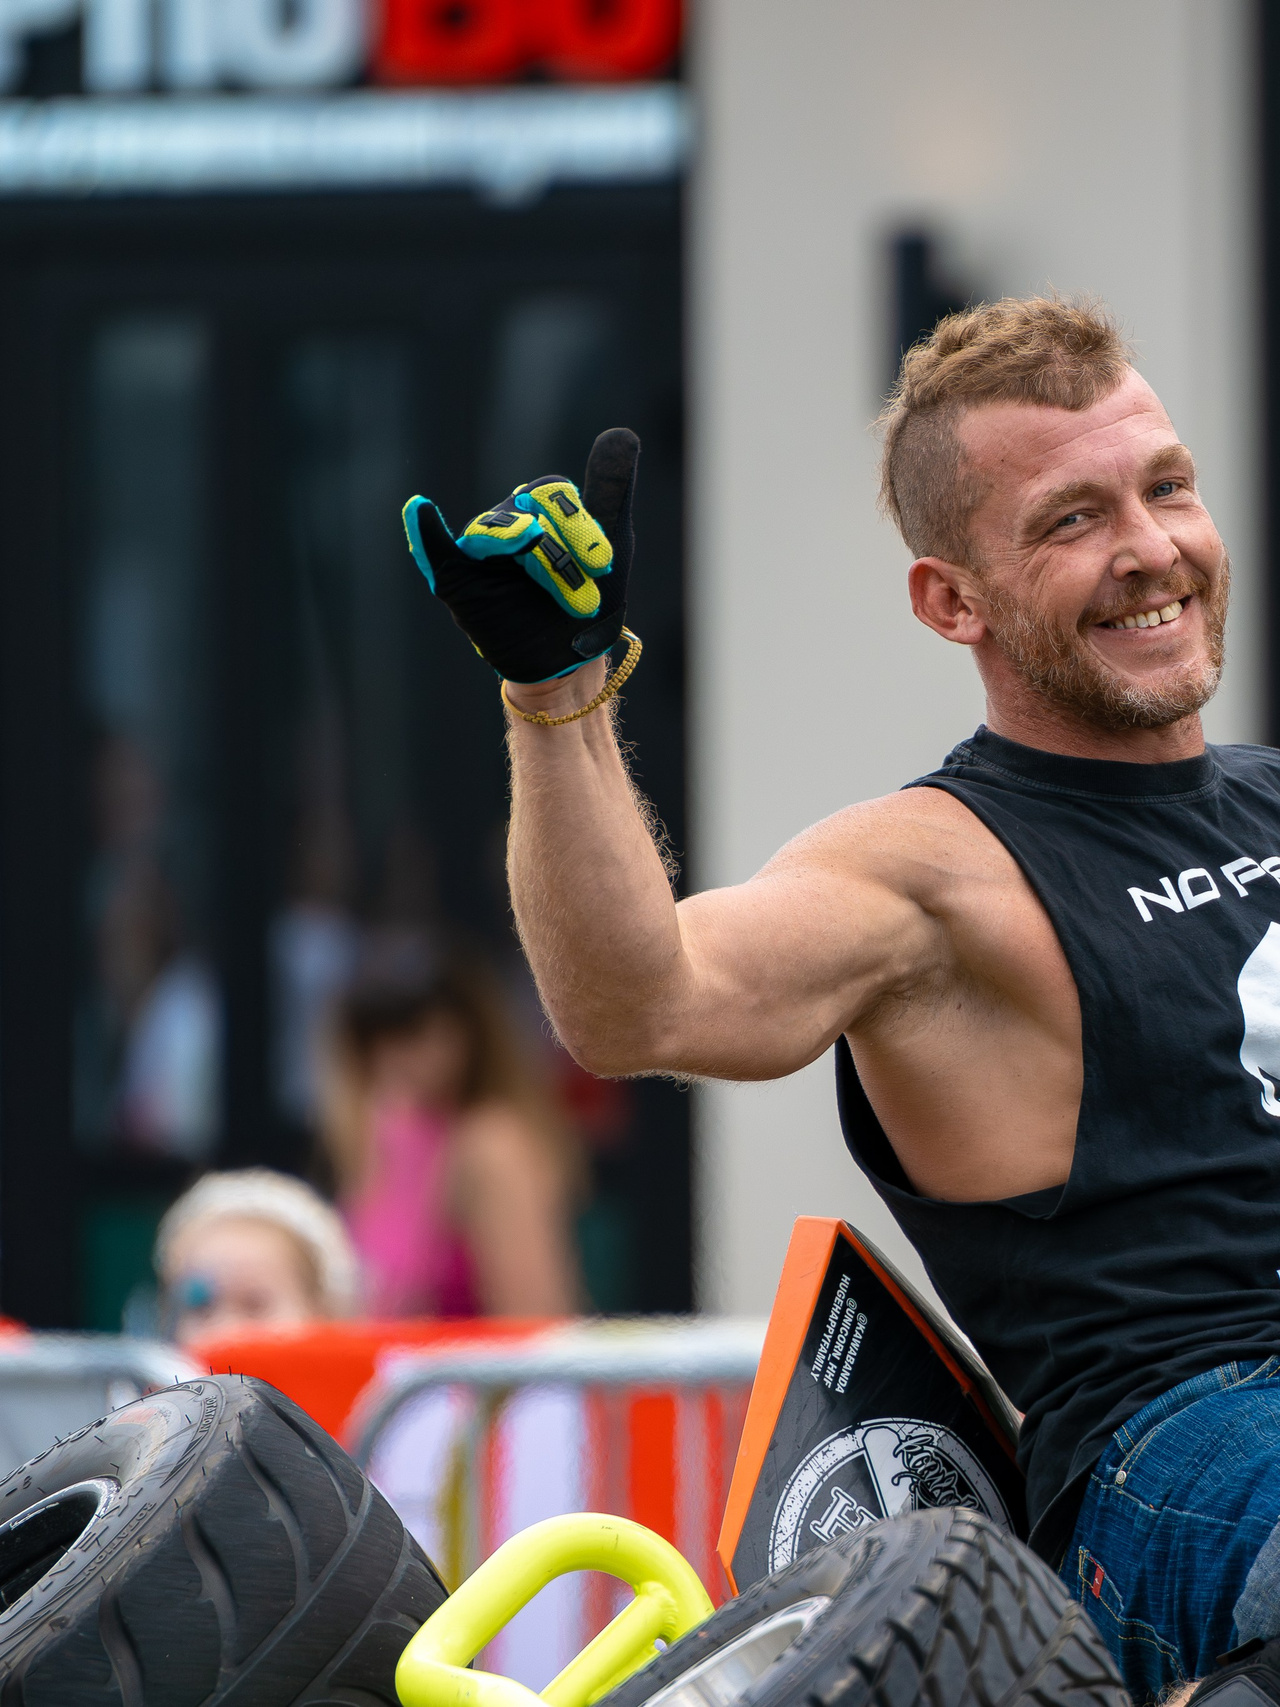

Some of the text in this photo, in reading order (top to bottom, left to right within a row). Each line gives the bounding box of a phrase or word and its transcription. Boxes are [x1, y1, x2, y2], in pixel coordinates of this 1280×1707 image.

[1127, 867, 1221, 923] NO
[810, 1273, 851, 1382] HUGEHAPPYFAMILY
[823, 1297, 857, 1389] @UNICORN_HHF
[835, 1312, 868, 1394] @KAWABANDA
[84, 1502, 157, 1578] ROTATION
